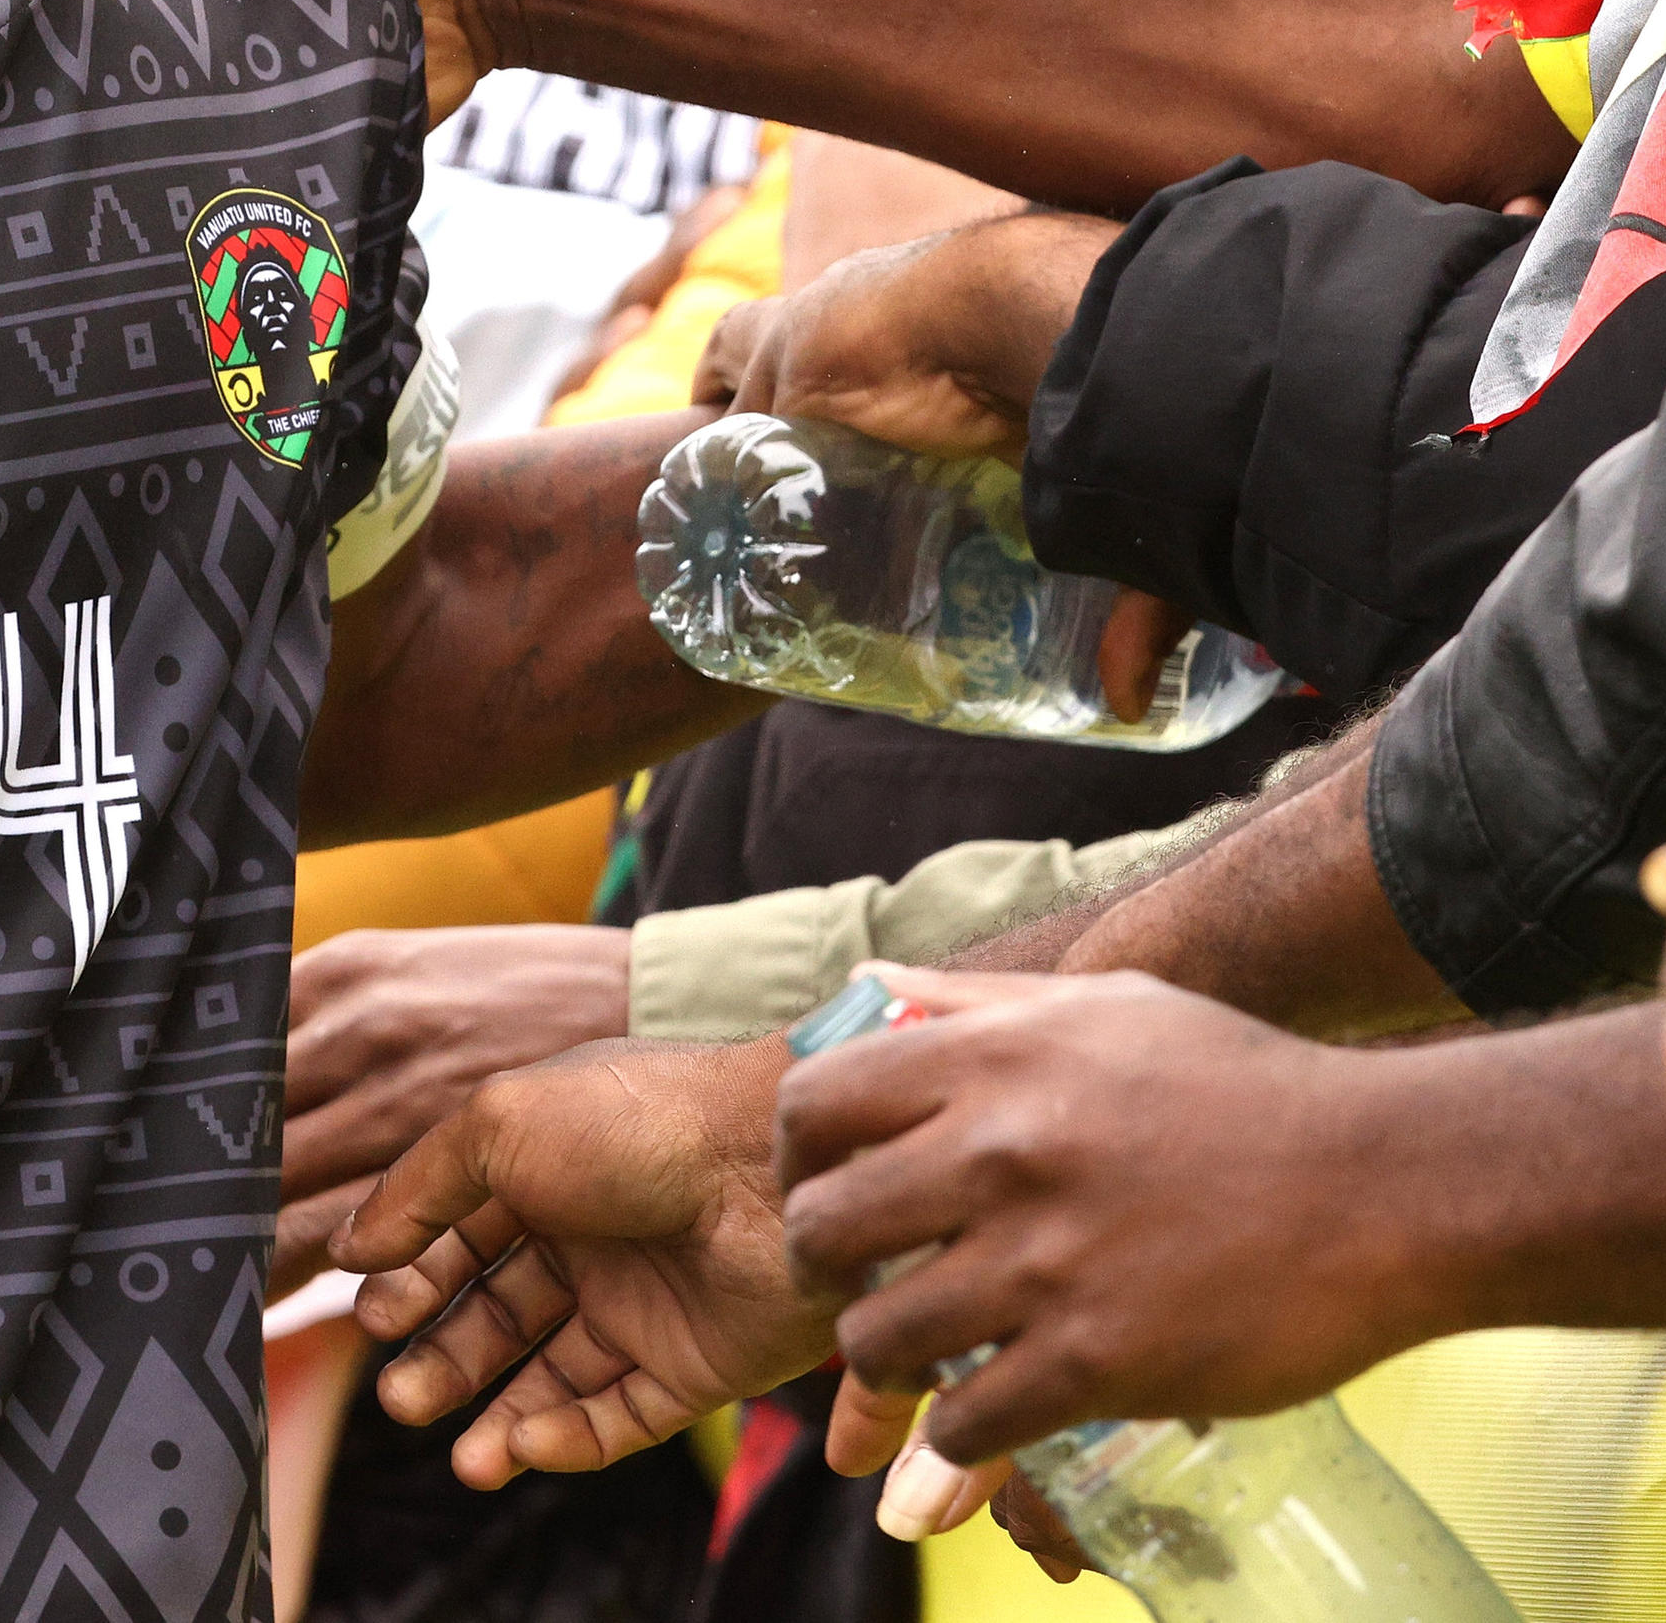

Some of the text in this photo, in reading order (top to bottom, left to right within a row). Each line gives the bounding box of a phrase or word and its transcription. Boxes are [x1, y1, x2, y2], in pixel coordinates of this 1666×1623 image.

[196, 202, 312, 250] VANUATU UNITED FC
[267, 416, 291, 434] THE
